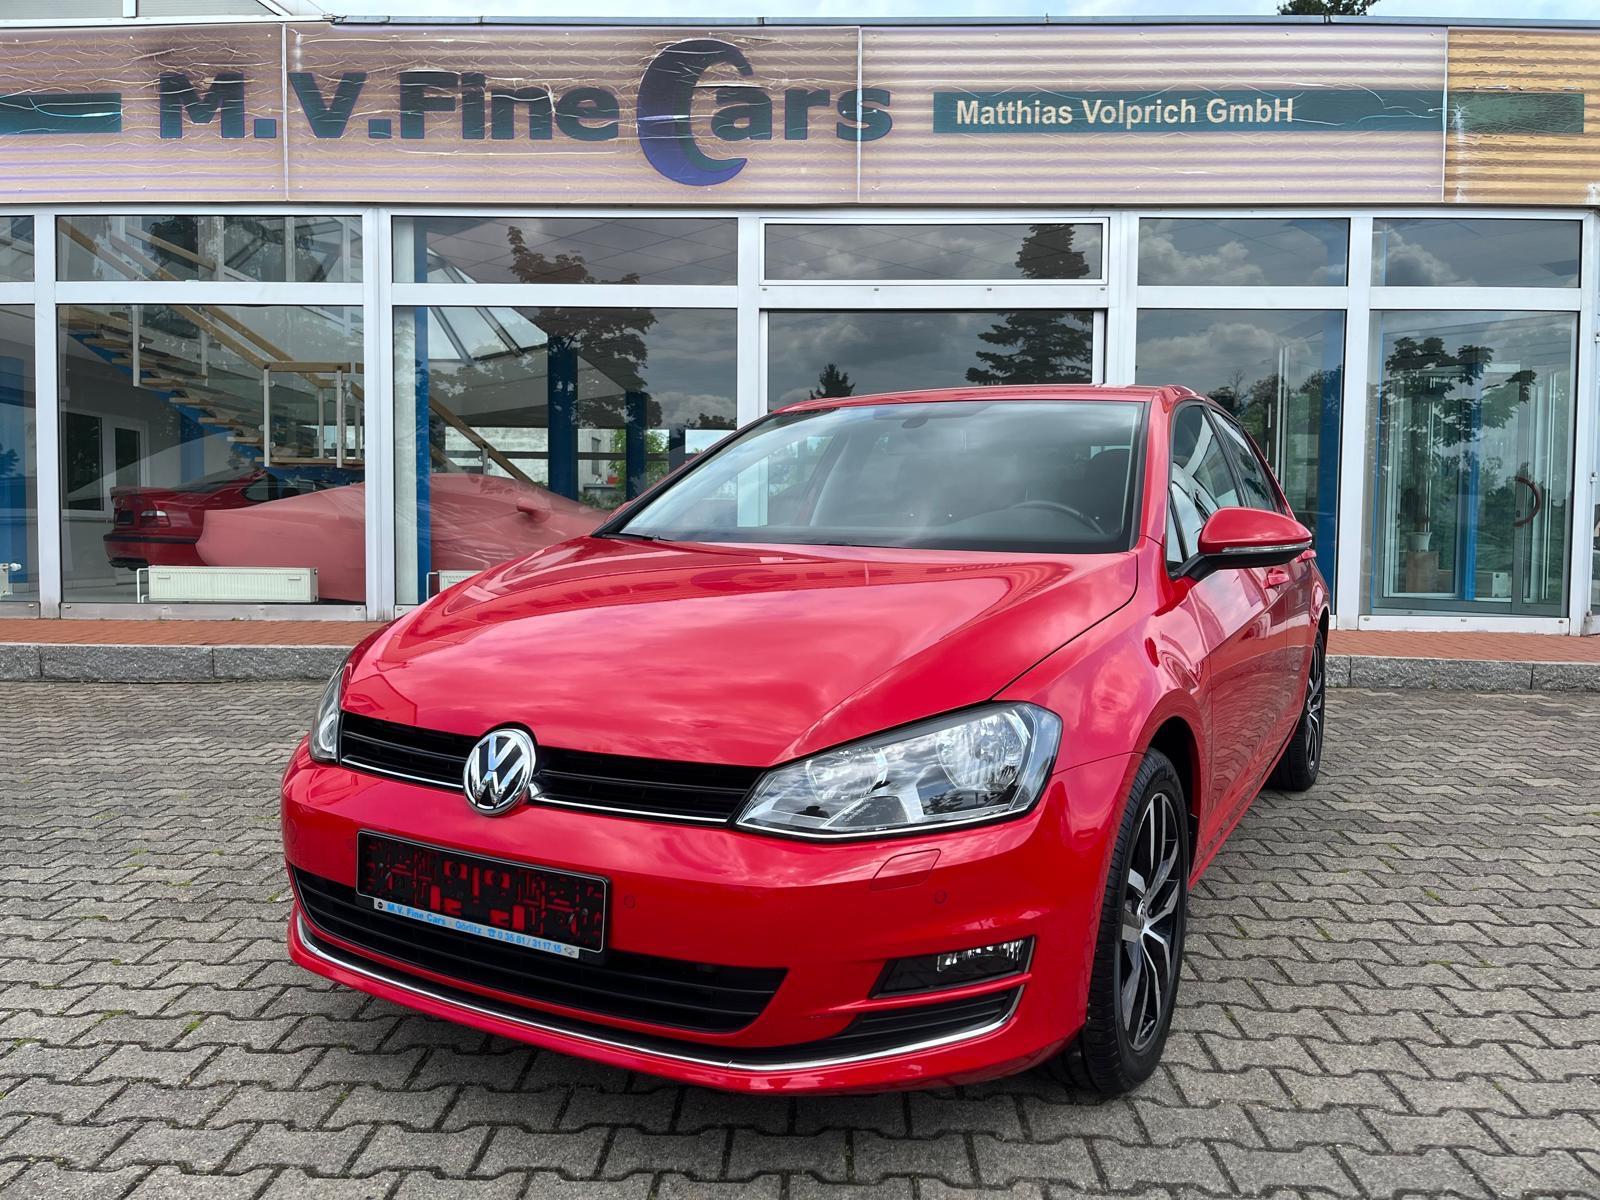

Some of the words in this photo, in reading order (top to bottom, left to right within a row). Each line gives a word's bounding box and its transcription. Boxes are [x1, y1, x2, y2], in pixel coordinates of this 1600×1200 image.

[636, 38, 893, 186] Cars
[956, 99, 1073, 126] Matthias
[1082, 97, 1196, 130] Volprich
[1206, 97, 1294, 124] GmbH
[406, 907, 424, 919] Fine
[426, 912, 446, 925] Cars
[455, 920, 482, 934] Görlitz
